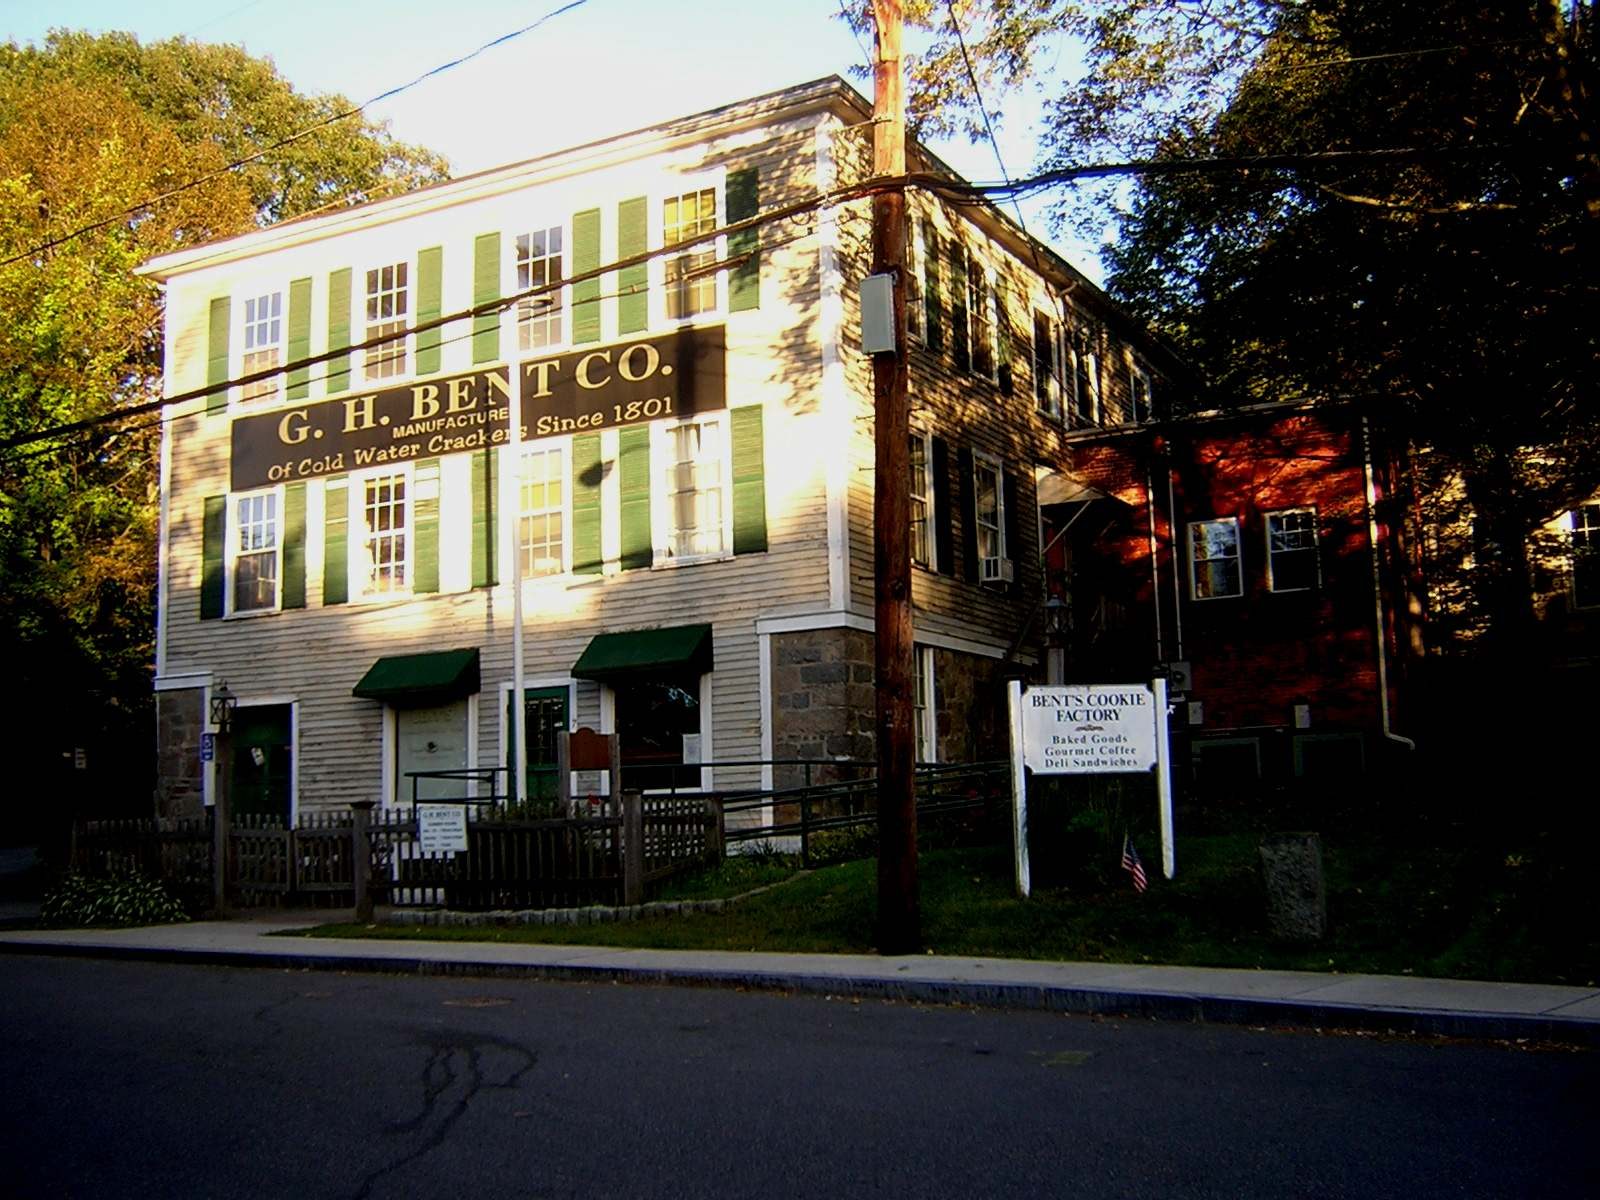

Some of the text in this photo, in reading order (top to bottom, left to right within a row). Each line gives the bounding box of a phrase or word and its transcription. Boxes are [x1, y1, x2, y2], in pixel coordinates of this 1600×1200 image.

[278, 343, 673, 445] G. H. BENT CO.
[267, 461, 293, 481] Of
[298, 453, 344, 476] Cold
[354, 444, 420, 465] Water
[536, 411, 604, 436] Since
[614, 396, 673, 423] 1801
[1032, 693, 1146, 707] BENT'S COOKIE
[1056, 709, 1122, 722] FACTORY
[1052, 734, 1128, 745] Baked Goods
[1045, 745, 1137, 756] Gourmet Coffee
[1045, 758, 1138, 768] Deli Sandwiches
